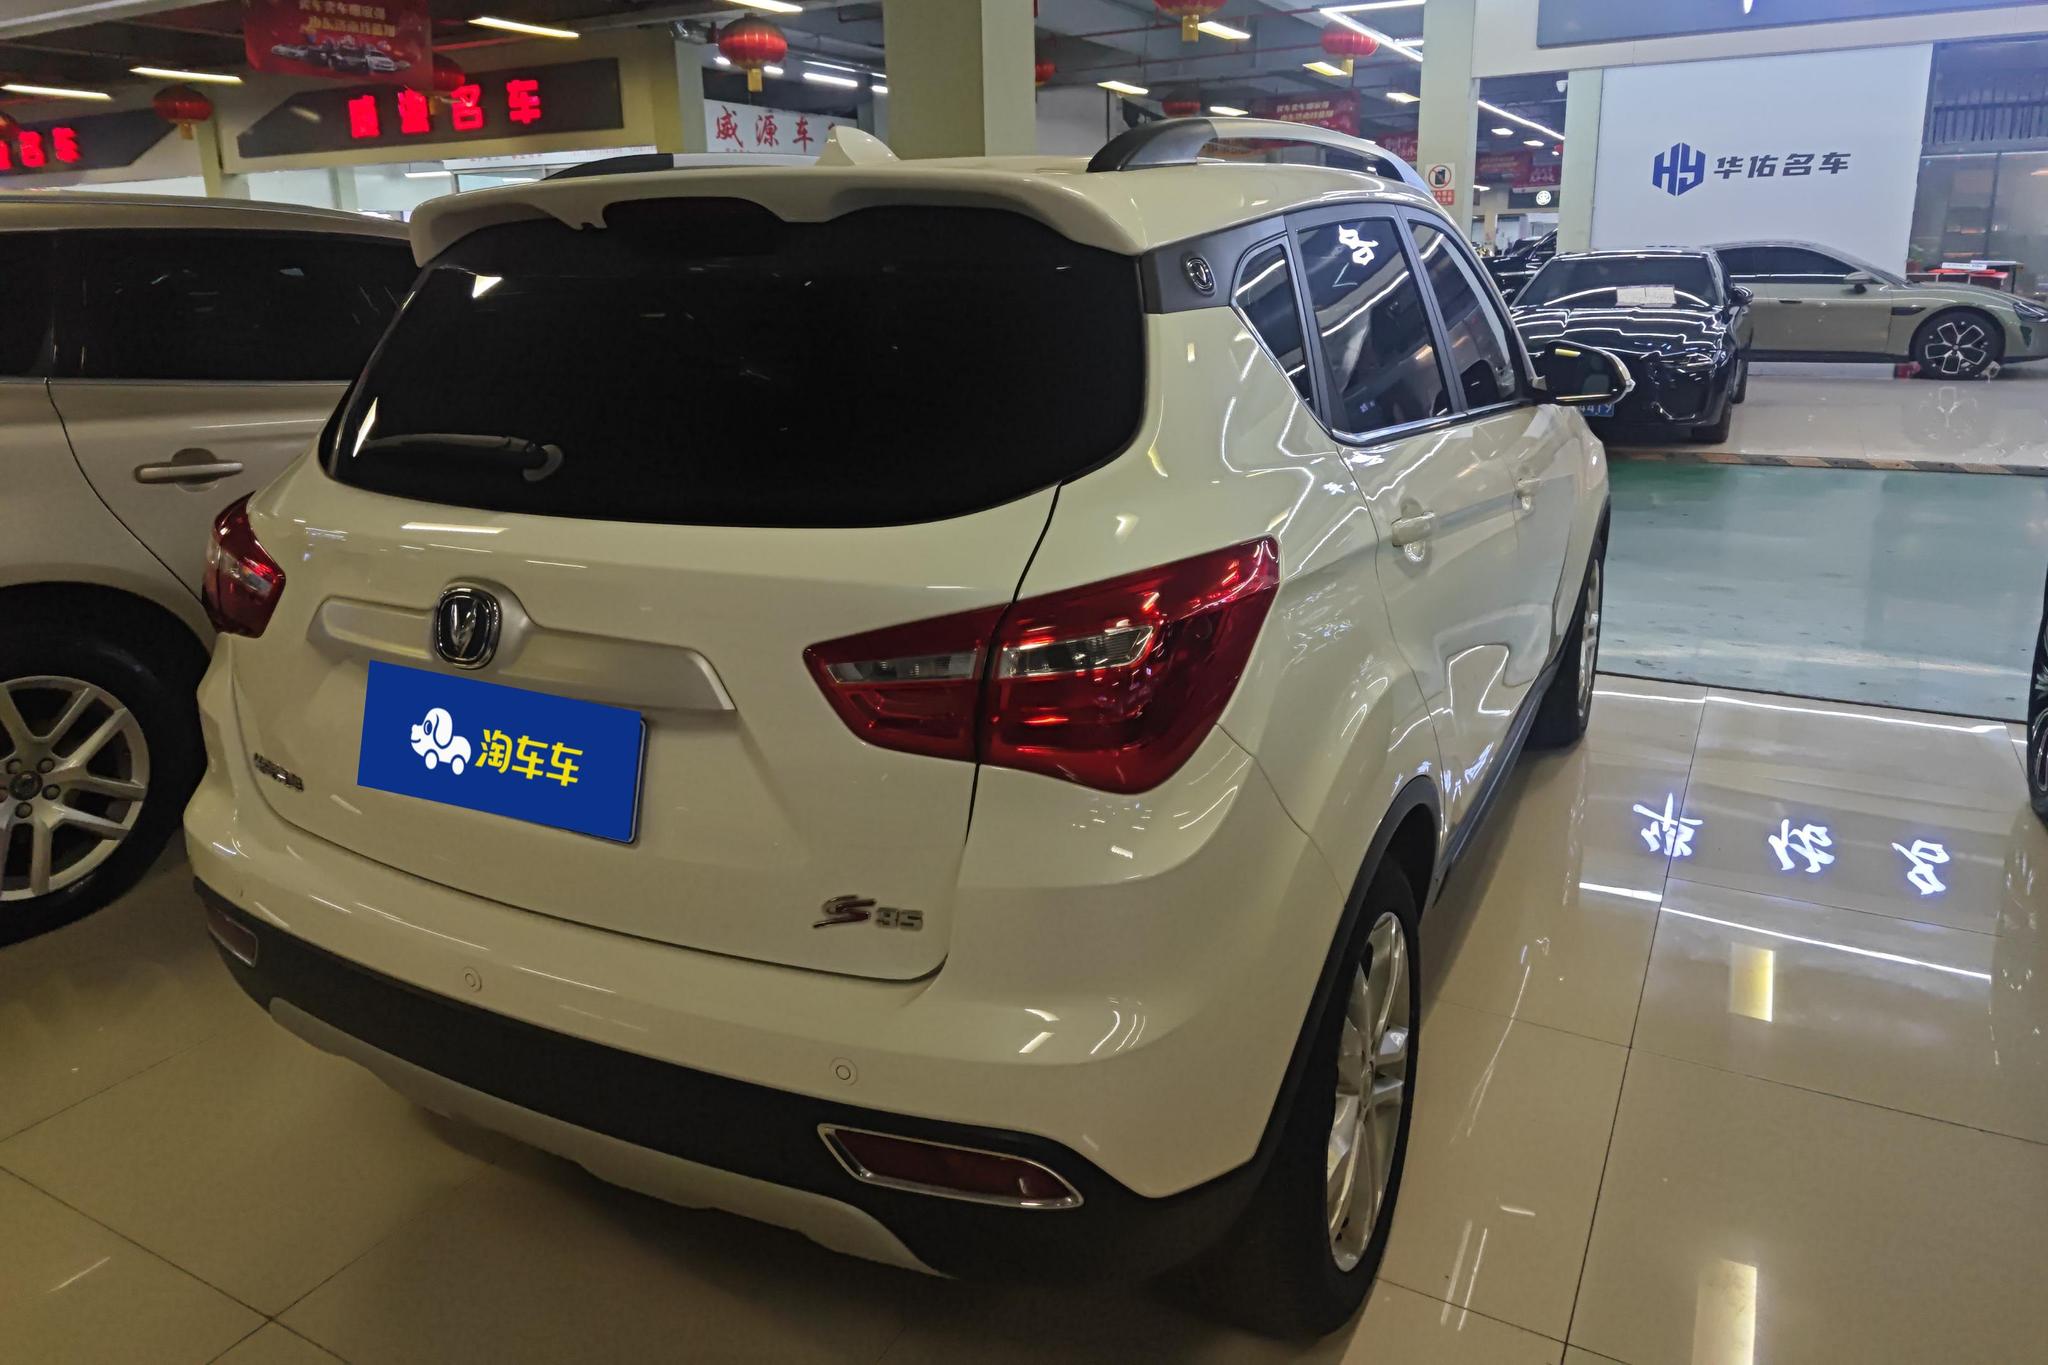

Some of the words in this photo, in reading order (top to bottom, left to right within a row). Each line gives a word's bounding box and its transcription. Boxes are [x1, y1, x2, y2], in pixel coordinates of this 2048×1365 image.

[715, 105, 836, 152] 威源车
[1652, 142, 1706, 196] HY
[1714, 151, 1851, 180] 华佑名车
